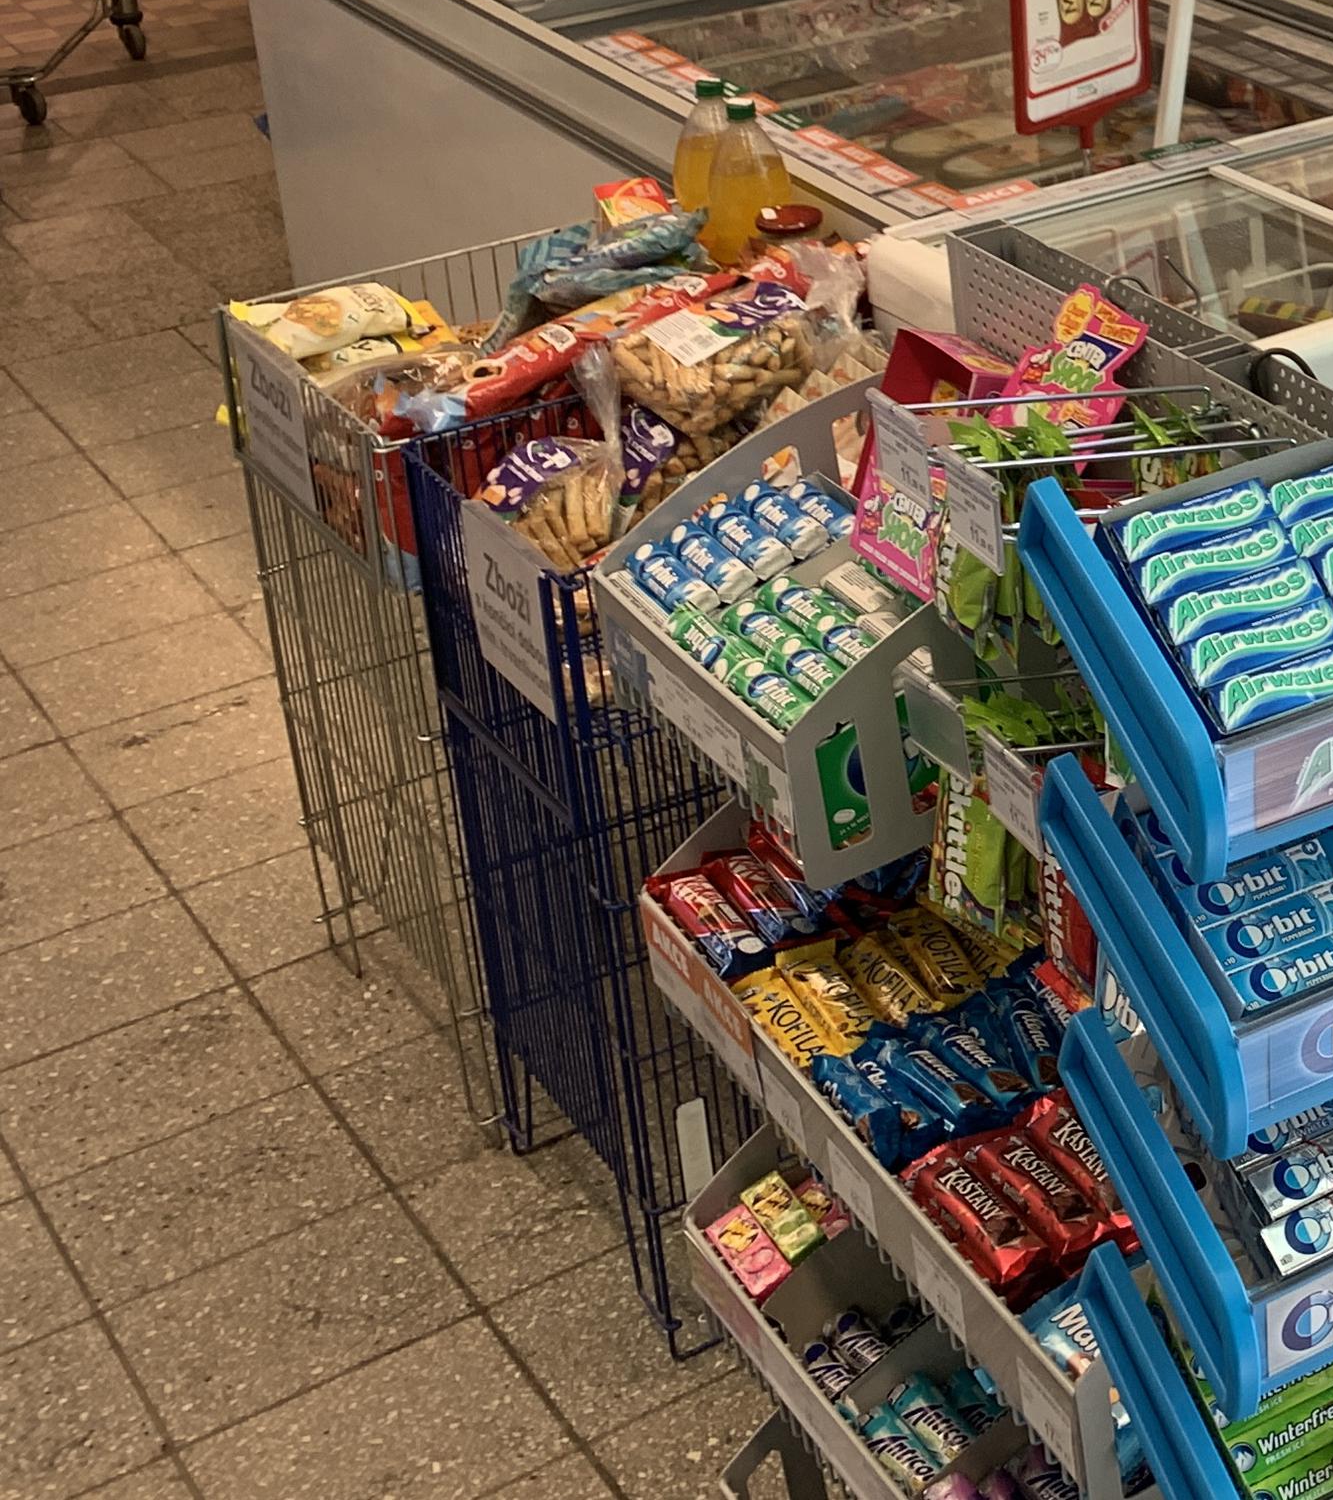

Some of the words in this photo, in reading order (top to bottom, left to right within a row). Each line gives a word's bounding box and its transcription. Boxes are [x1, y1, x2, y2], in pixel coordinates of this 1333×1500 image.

[249, 356, 295, 423] Zboží
[1129, 488, 1259, 550] Airwaves
[483, 554, 533, 620] Zboží
[1174, 569, 1308, 630] Airwaves
[937, 1166, 1001, 1222] KAŠTANY
[1003, 1143, 1067, 1197] KAŠTANY
